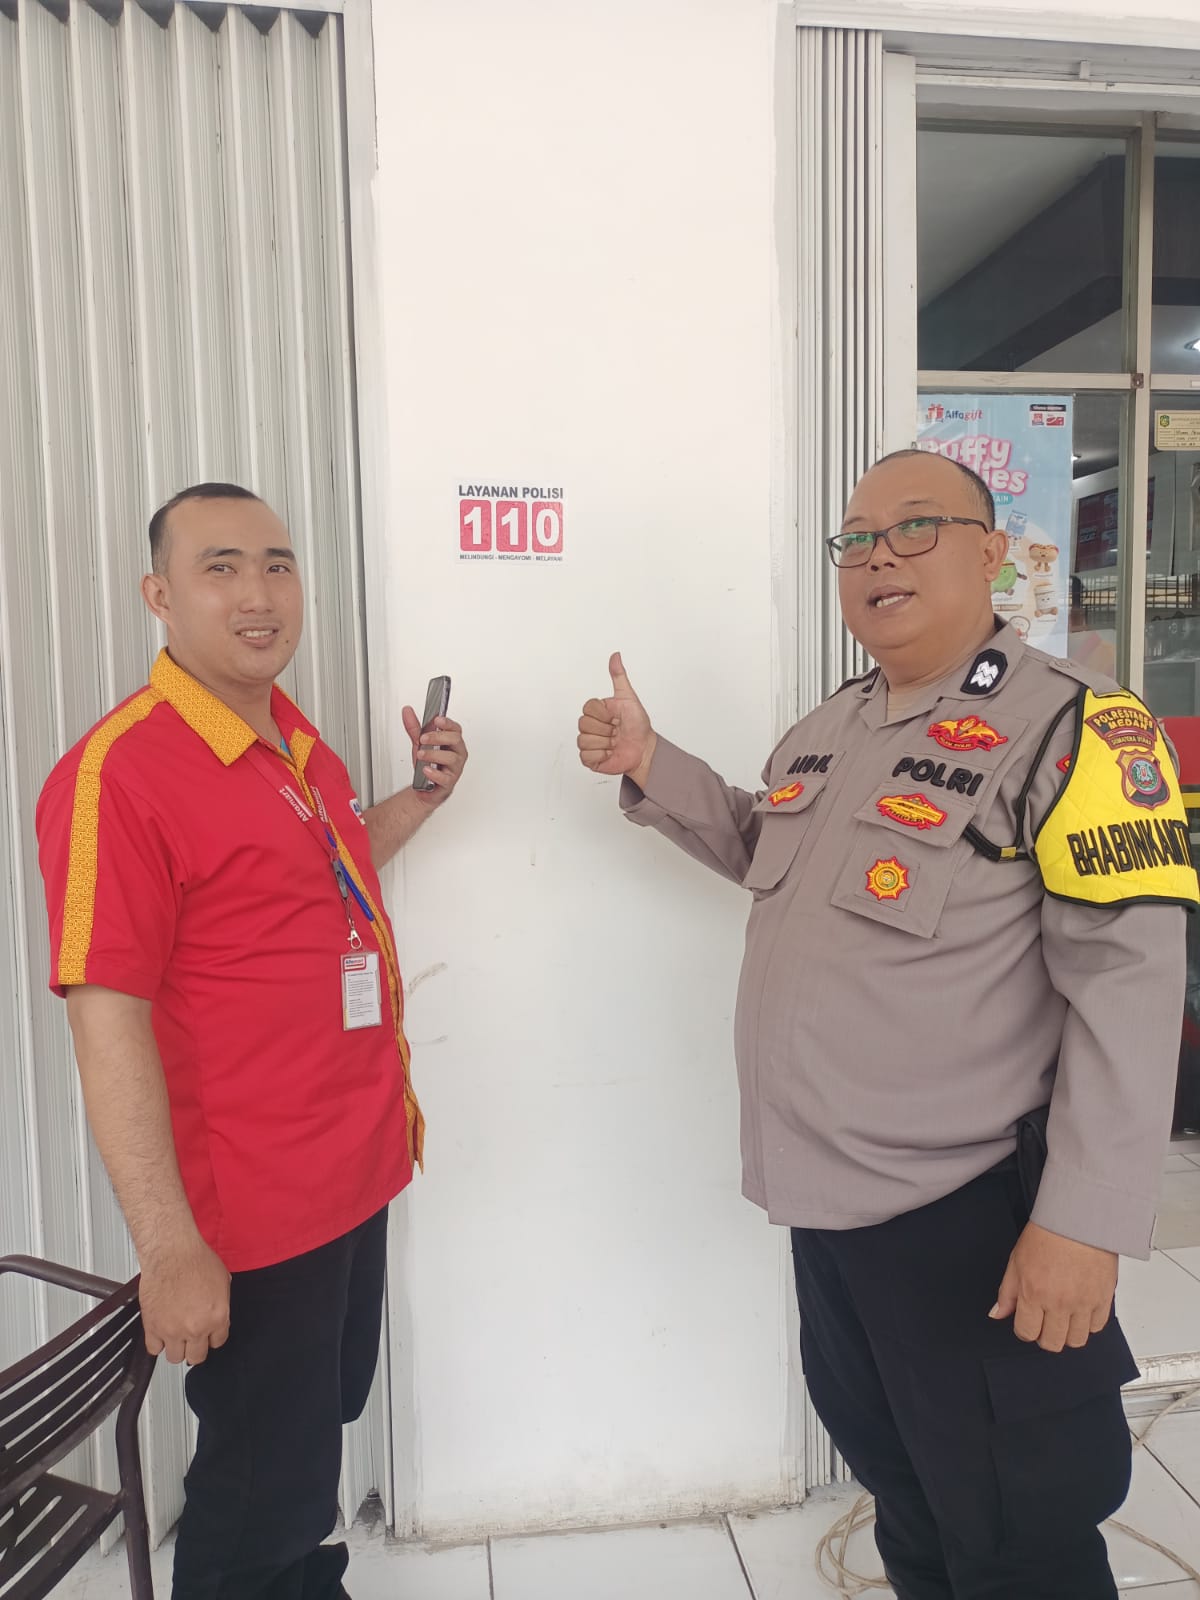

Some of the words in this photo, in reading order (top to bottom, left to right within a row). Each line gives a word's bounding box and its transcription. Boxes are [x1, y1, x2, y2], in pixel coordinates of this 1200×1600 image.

[945, 409, 983, 421] Alfagift
[458, 485, 518, 498] LAYANAN
[522, 487, 563, 499] POLISI
[463, 506, 560, 547] 110
[1107, 719, 1148, 730] MEDAN
[892, 757, 984, 797] POLRI
[279, 787, 309, 822] Alfamart
